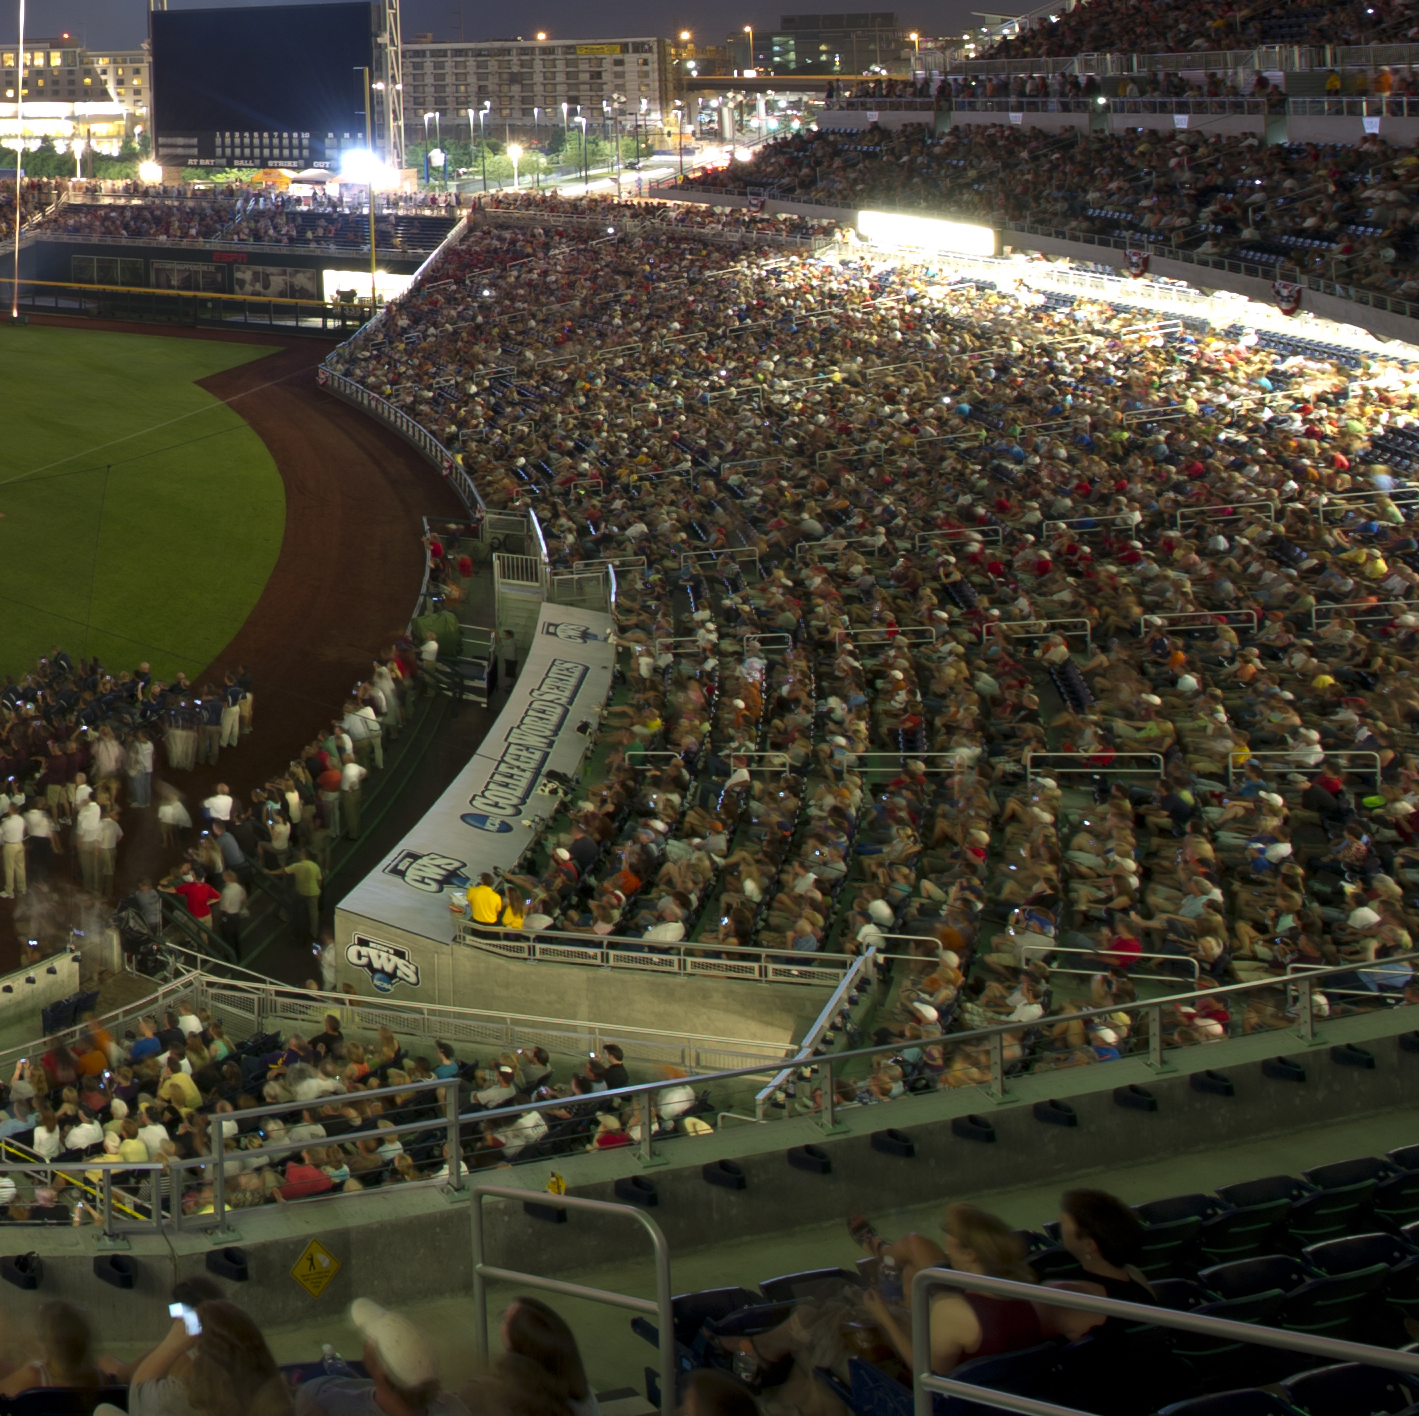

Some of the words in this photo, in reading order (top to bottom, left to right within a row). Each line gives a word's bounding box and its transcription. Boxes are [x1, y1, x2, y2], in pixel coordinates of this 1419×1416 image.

[213, 252, 247, 263] ESPN
[529, 658, 591, 706] SERIES
[494, 699, 571, 753] WORLD
[469, 741, 550, 817] COLLEGE
[403, 852, 467, 893] CWS
[347, 945, 419, 985] CWS
